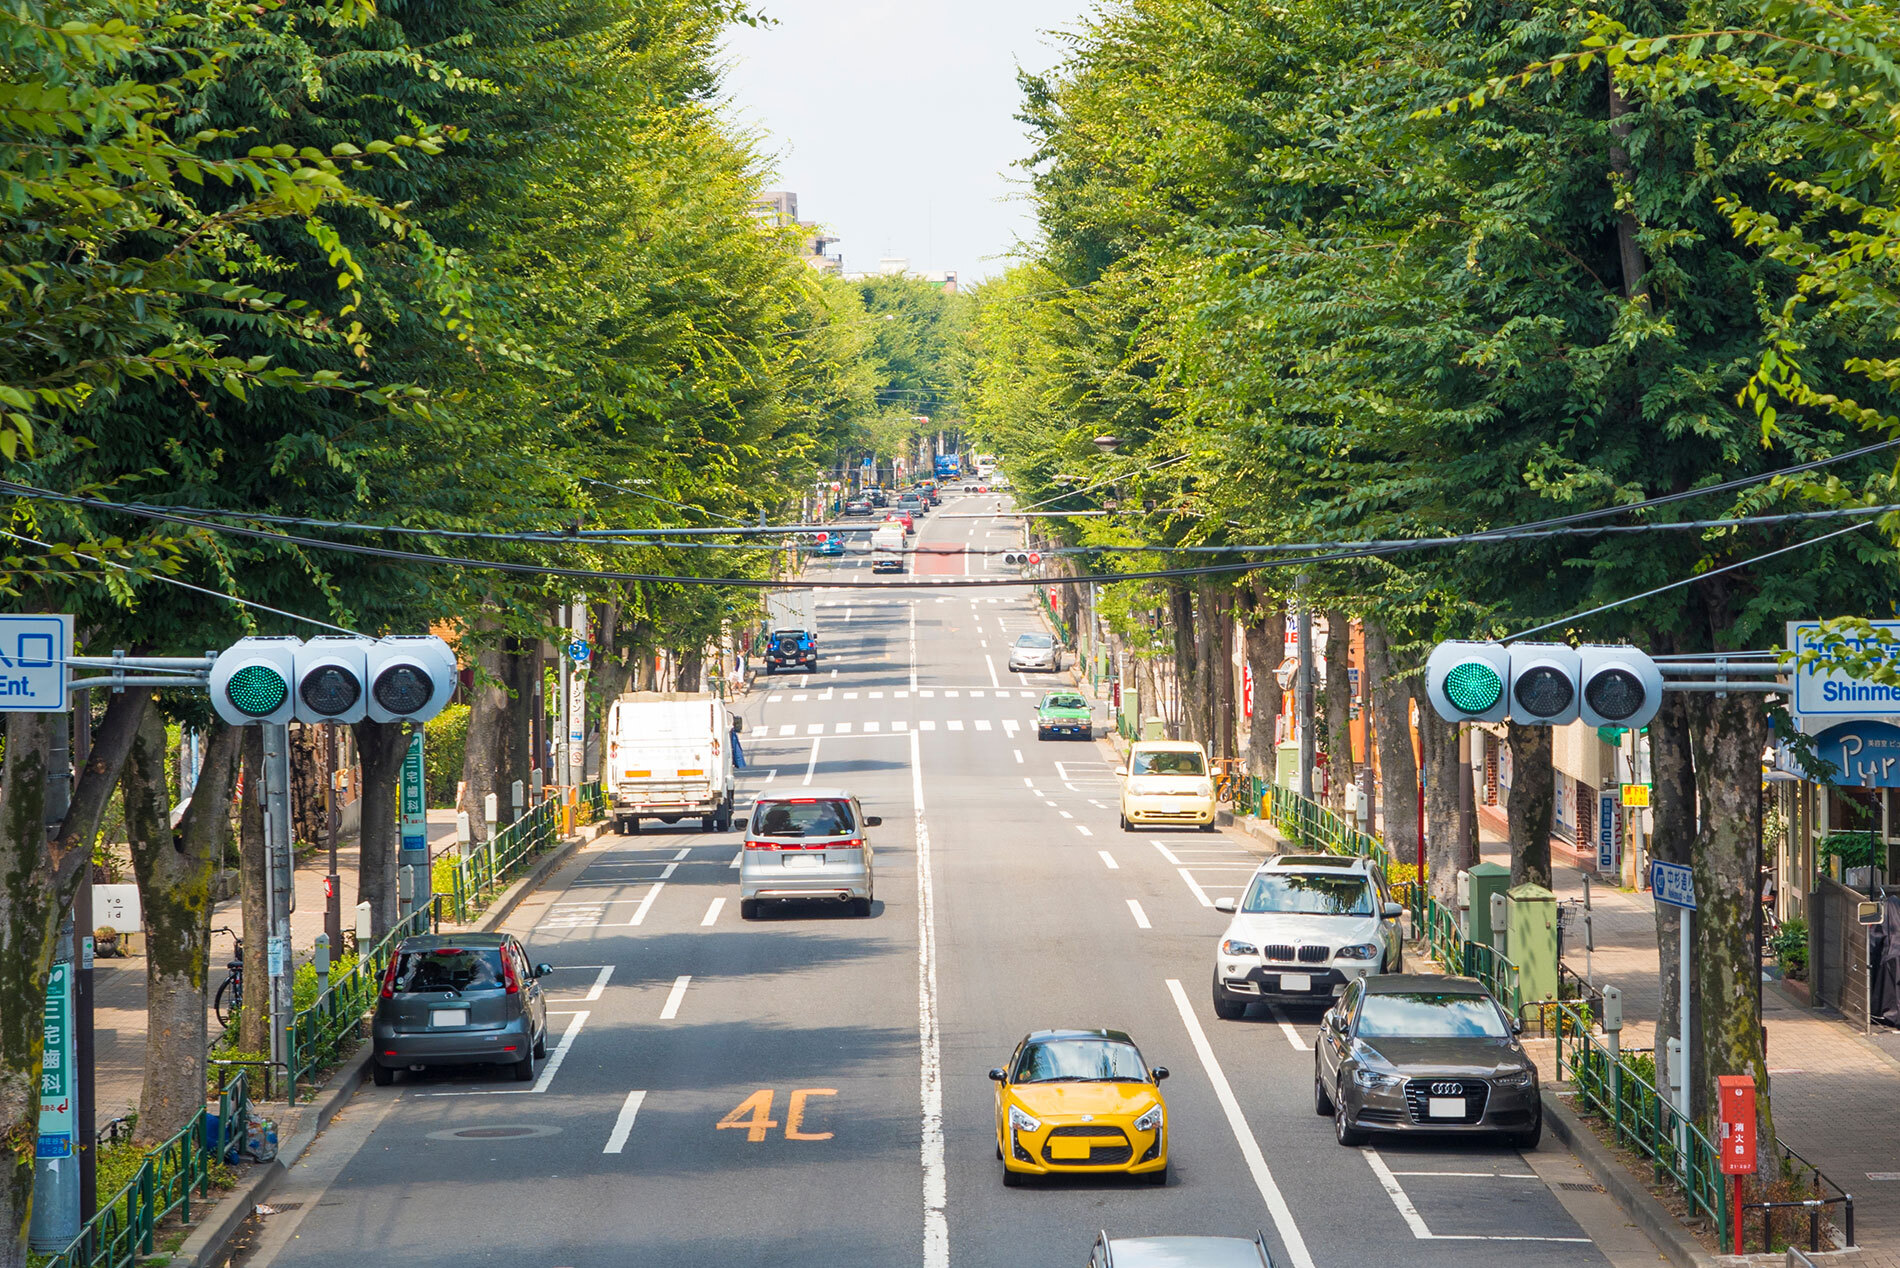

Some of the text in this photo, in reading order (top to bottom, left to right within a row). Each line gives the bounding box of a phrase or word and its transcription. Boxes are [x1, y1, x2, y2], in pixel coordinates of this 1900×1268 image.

[42, 1000, 61, 1094] 三宅歯科
[1735, 1123, 1744, 1155] 消火器
